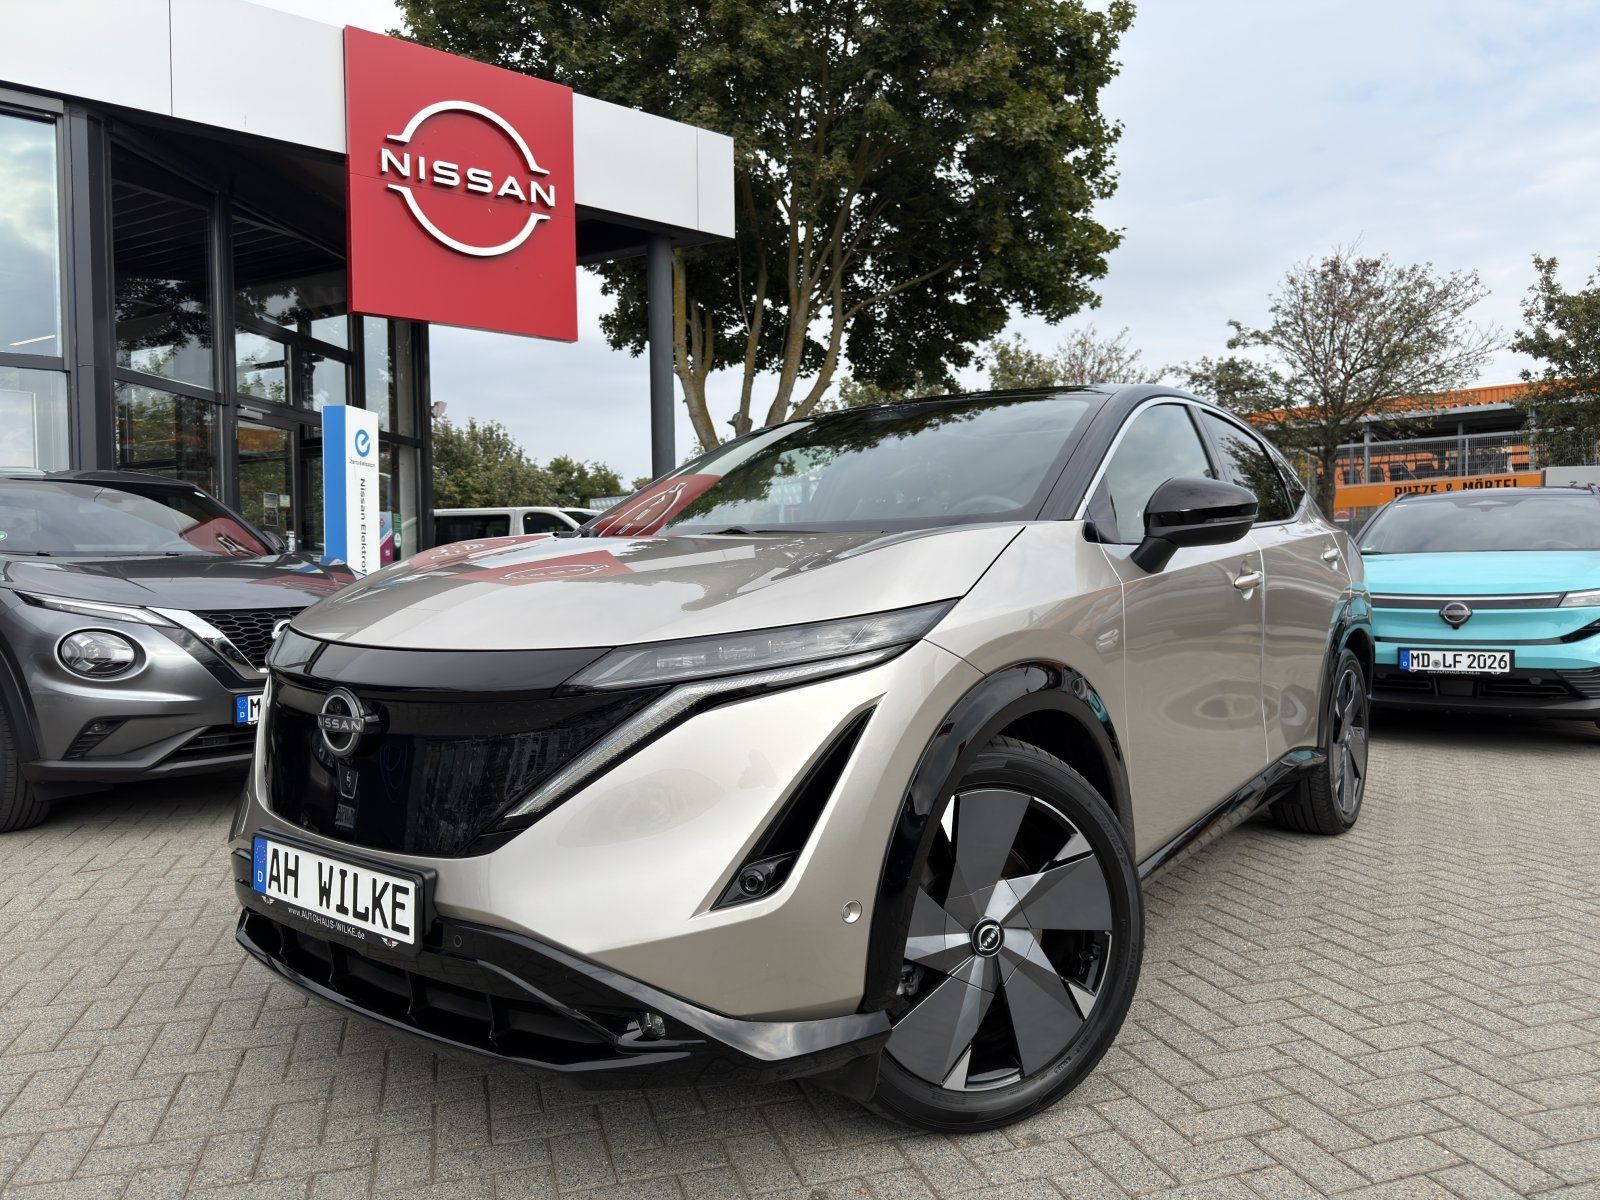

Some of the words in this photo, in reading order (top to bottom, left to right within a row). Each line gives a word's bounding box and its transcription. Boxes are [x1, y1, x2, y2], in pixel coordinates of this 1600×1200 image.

[381, 148, 556, 207] NISSAN
[1410, 653, 1430, 668] MD
[1442, 653, 1463, 669] LF
[1467, 654, 1508, 670] 2026
[268, 848, 299, 898] AH
[318, 861, 410, 936] WILKE
[288, 906, 366, 940] www.AUTOHAUS-WILKE.de
